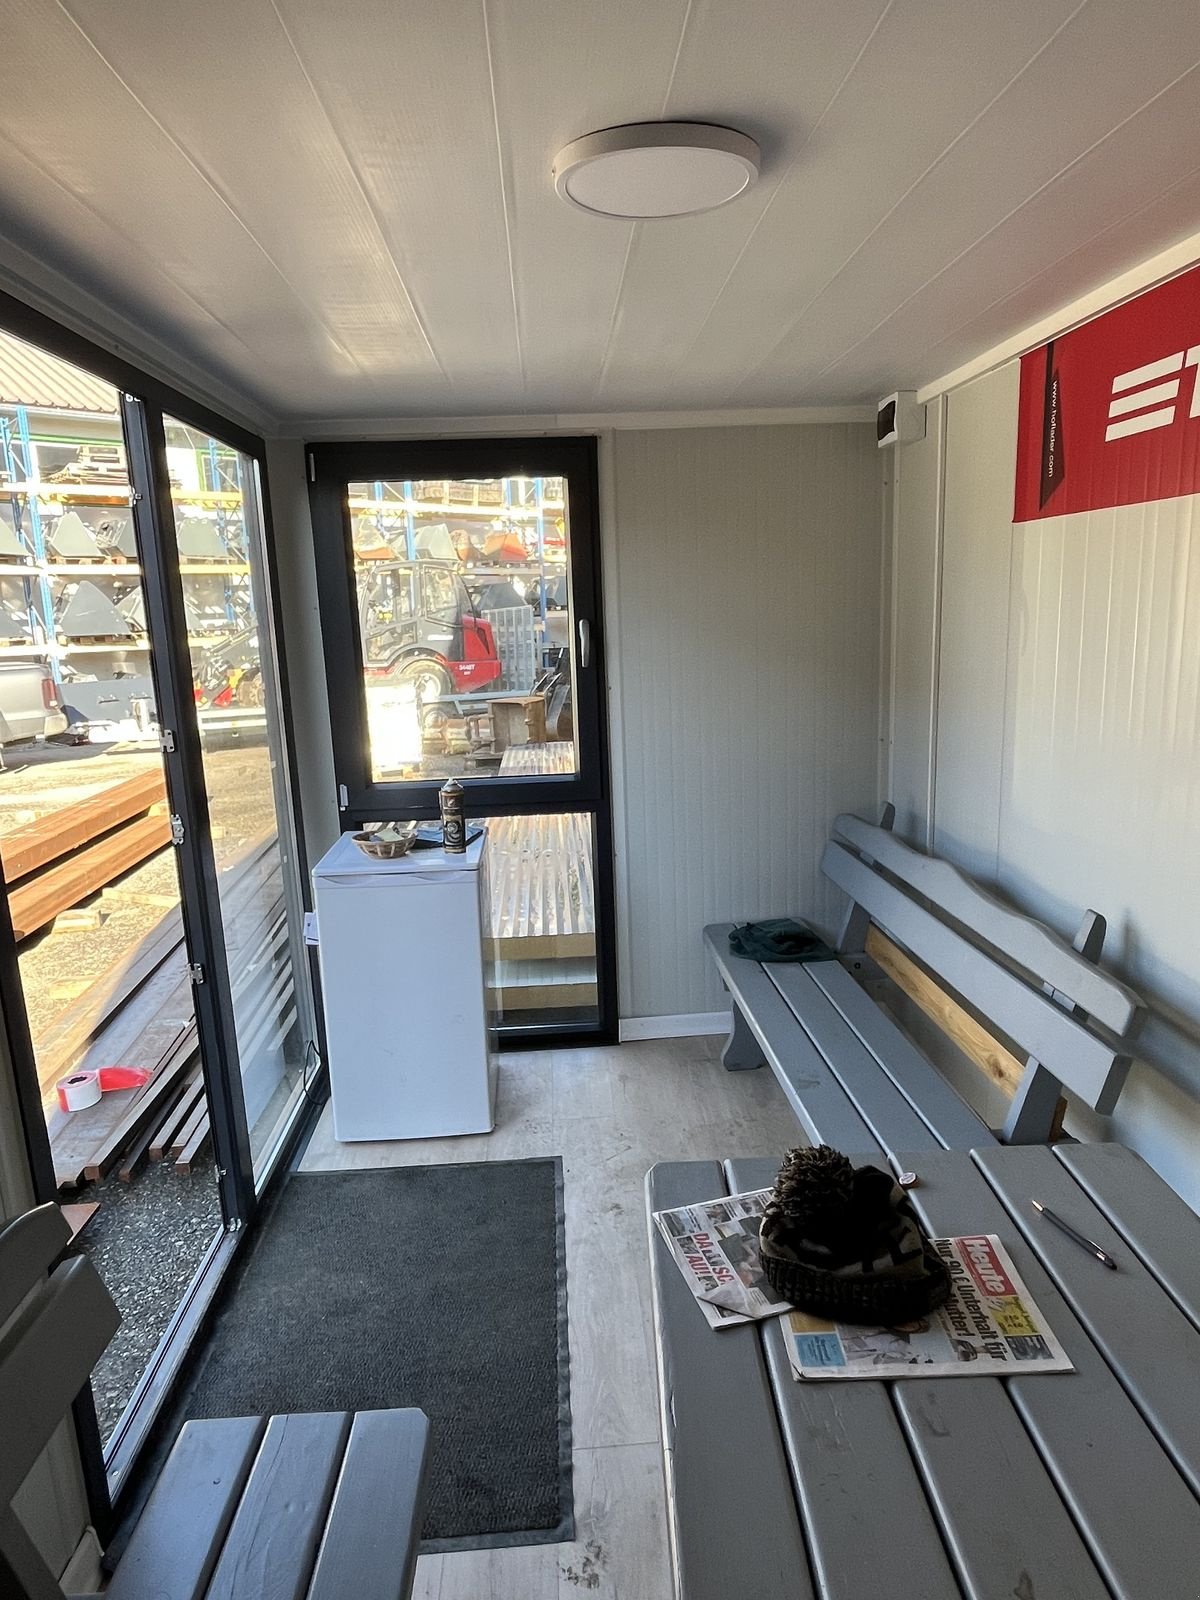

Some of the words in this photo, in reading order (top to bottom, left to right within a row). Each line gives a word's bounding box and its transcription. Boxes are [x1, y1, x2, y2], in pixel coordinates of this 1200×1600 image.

[1048, 380, 1058, 478] www.hoflader.com
[686, 1255, 711, 1275] AU!
[713, 1267, 735, 1285] SC
[961, 1239, 1006, 1292] Heute
[934, 1239, 953, 1259] Nur
[957, 1284, 998, 1340] Unterhalt
[984, 1341, 1007, 1361] für
